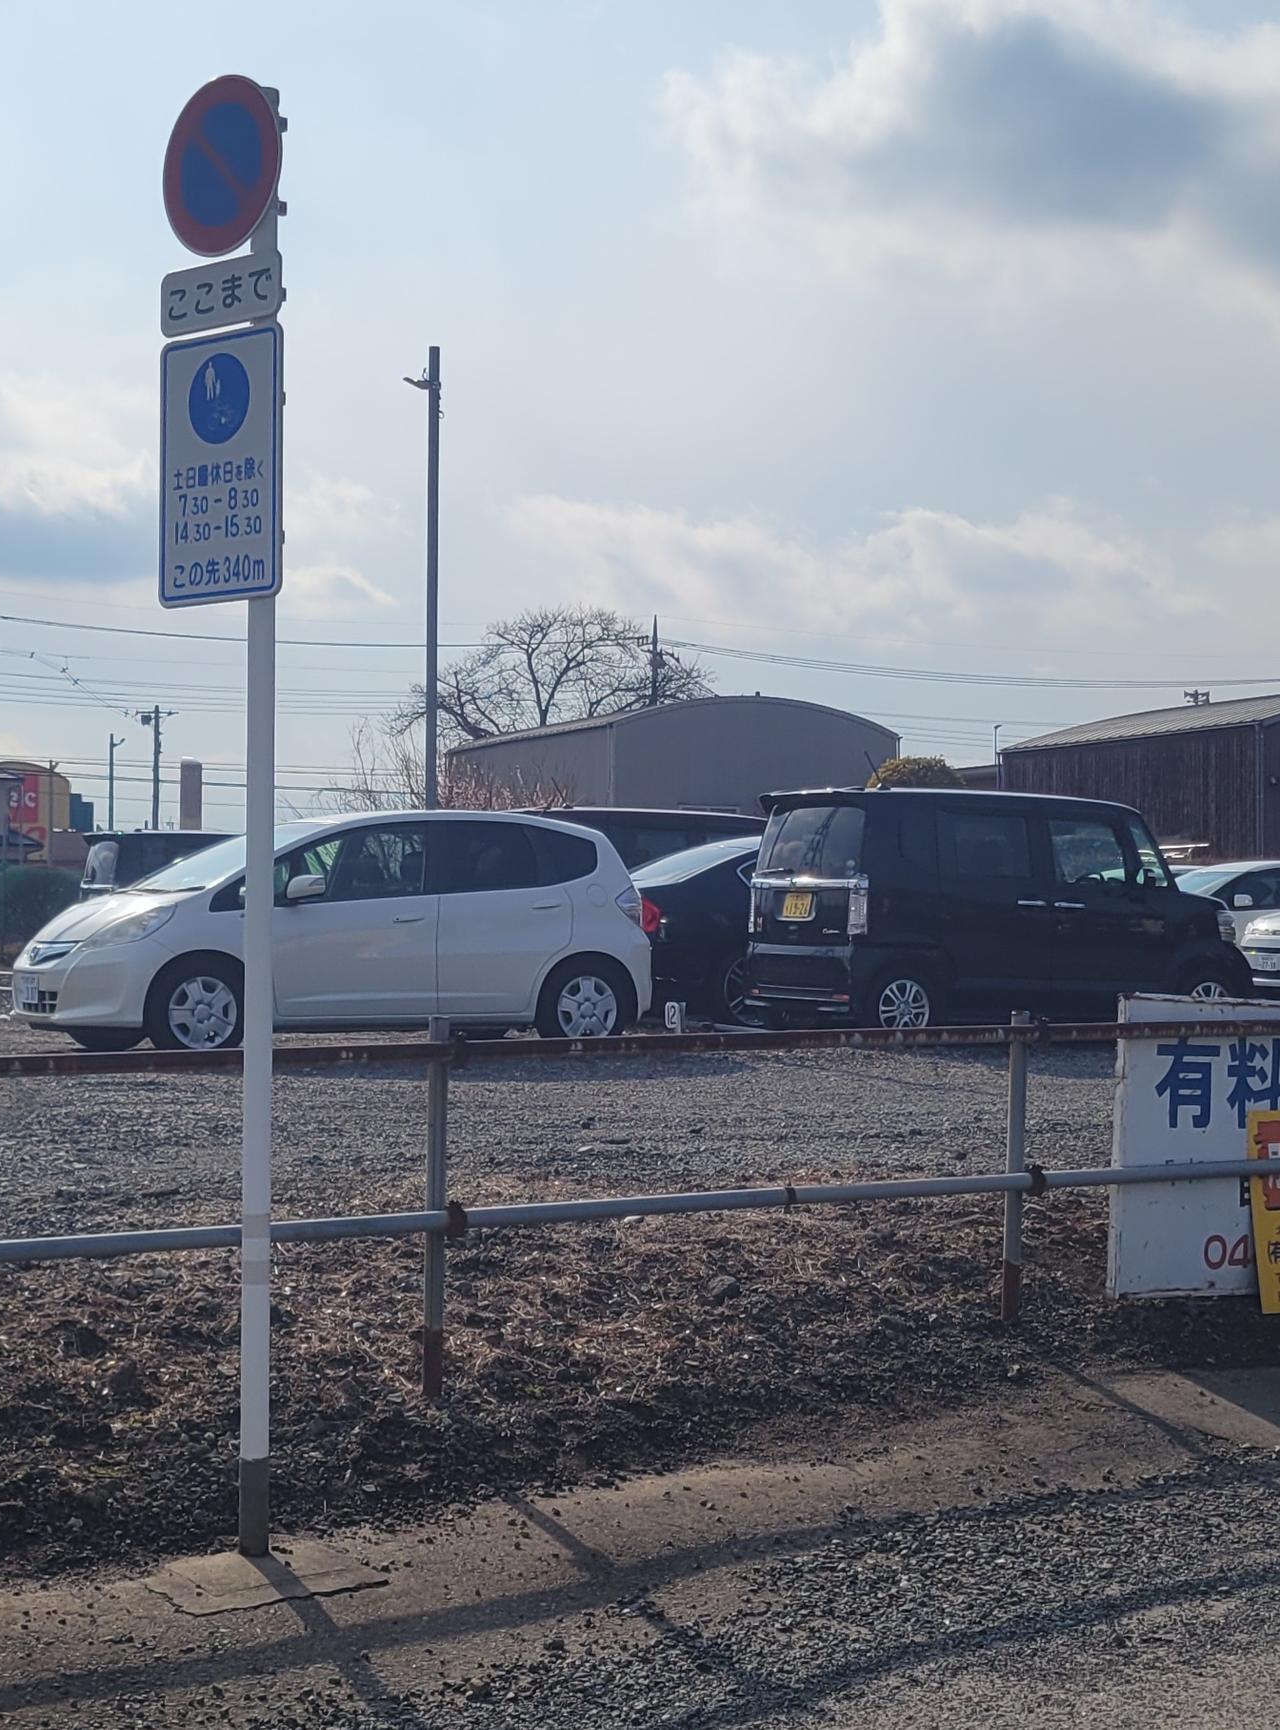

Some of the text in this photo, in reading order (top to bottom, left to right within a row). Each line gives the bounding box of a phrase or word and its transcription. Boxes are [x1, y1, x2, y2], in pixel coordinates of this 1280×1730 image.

[168, 267, 273, 321] ここまで
[173, 553, 265, 589] この先340m
